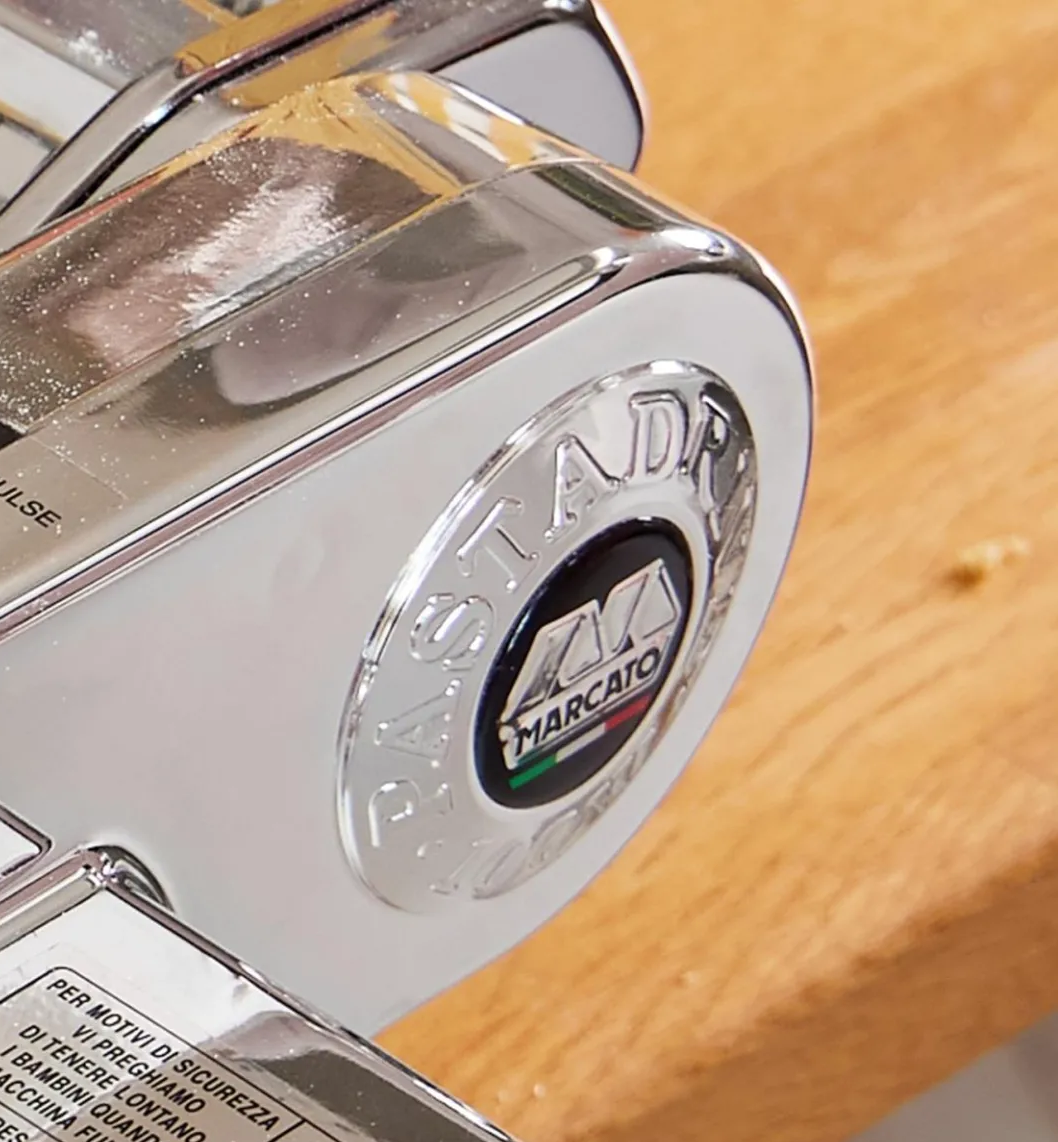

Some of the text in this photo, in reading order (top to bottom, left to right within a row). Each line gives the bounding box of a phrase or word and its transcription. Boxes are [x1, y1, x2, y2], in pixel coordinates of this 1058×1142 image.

[514, 646, 661, 758] MARCATO
[10, 1051, 96, 1107] BAMBINI
[18, 1024, 49, 1045] DI
[41, 1036, 120, 1090] TENERE
[46, 978, 281, 1132] PER MOTIVI DI SICUREZZA
[71, 1023, 206, 1114] VI PREGHIAMO
